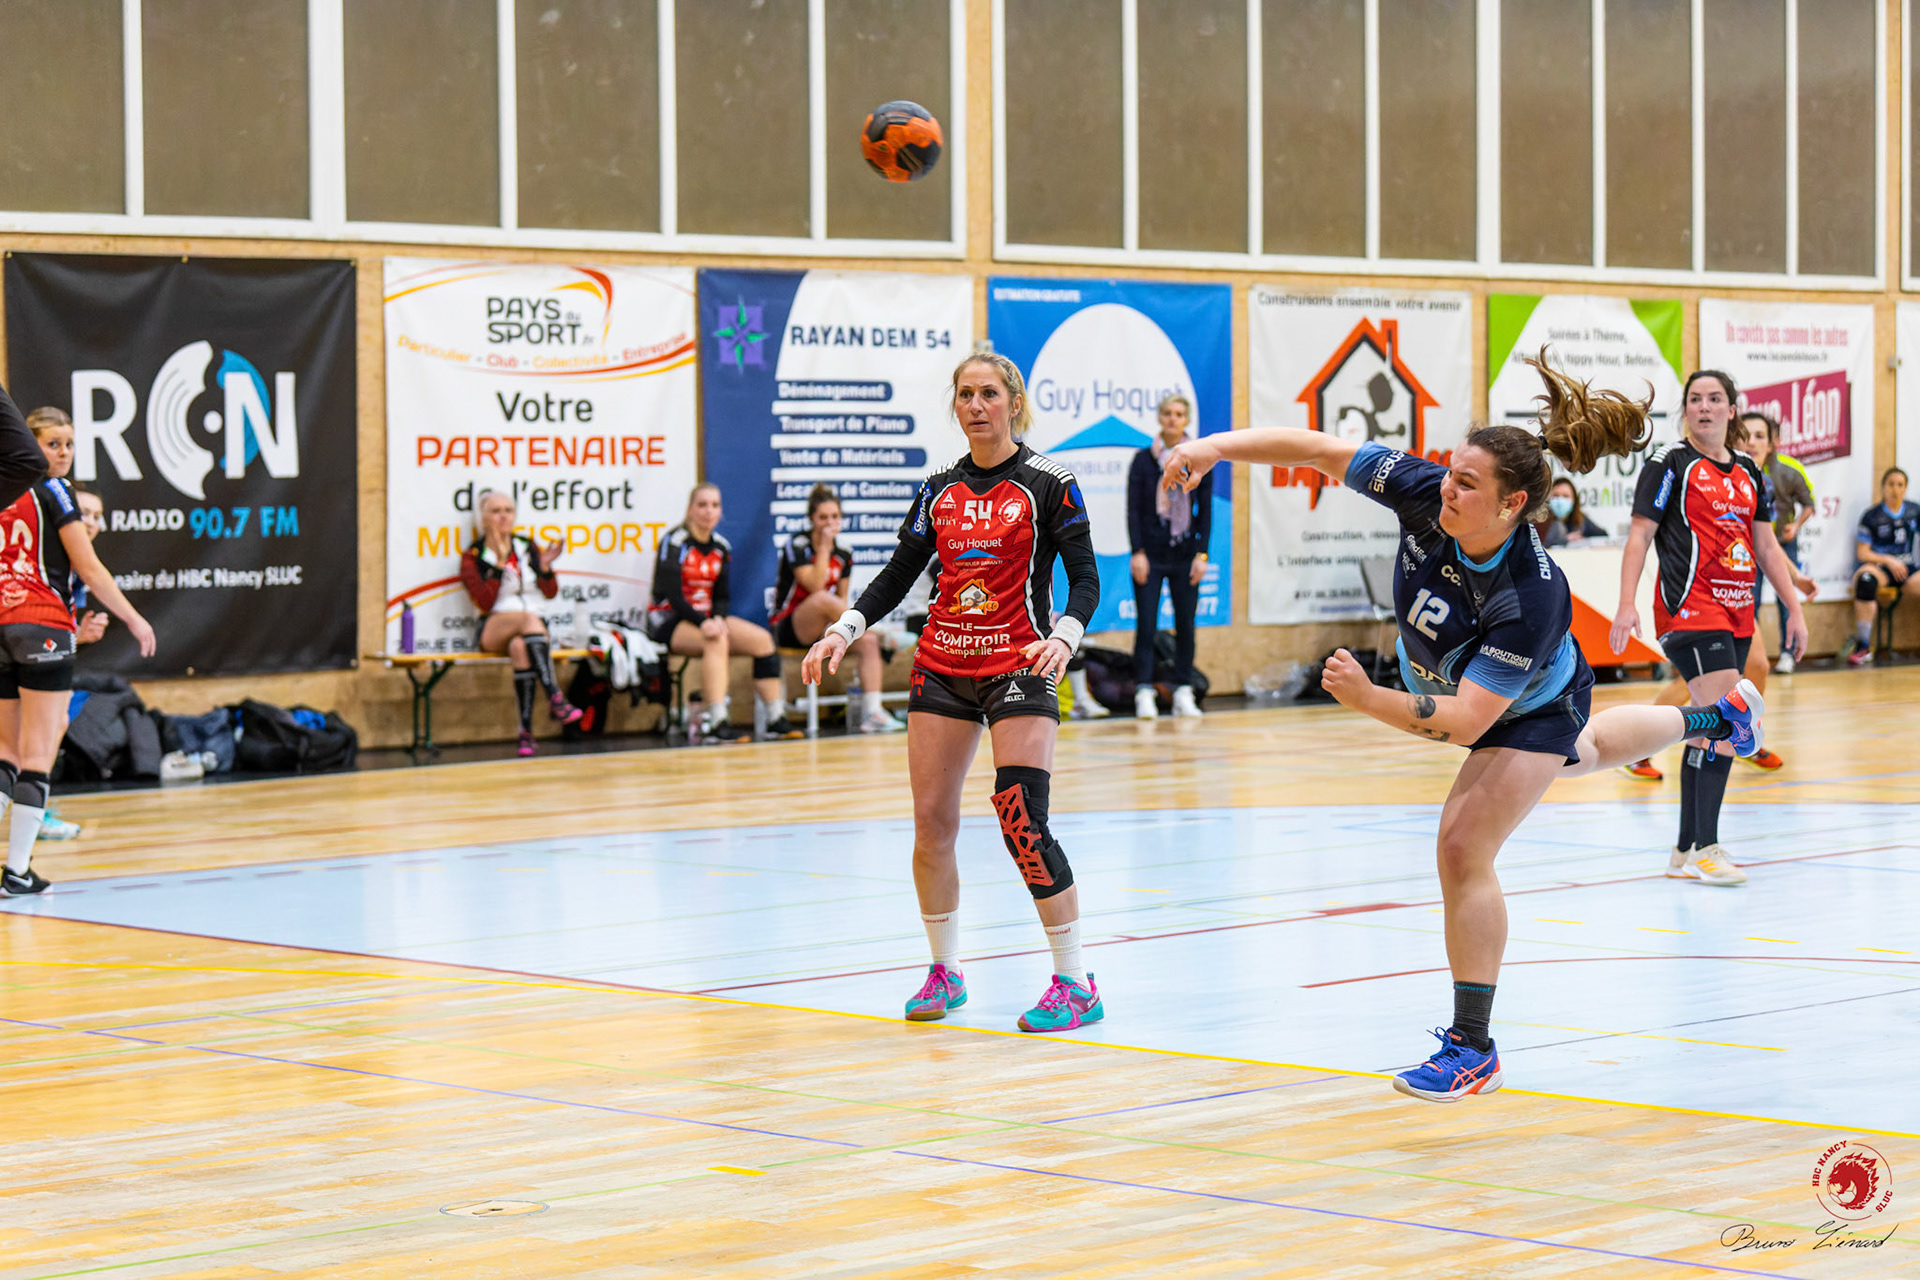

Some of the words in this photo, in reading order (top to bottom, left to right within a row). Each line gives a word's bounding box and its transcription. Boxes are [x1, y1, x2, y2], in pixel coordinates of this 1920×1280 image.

[487, 297, 561, 320] PAYS
[1258, 292, 1333, 307] Construisons
[1336, 296, 1391, 309] ensemble
[1395, 298, 1424, 310] votre
[1427, 300, 1463, 312] avenir
[790, 325, 865, 347] RAYAN
[871, 328, 917, 348] DEM
[925, 330, 952, 349] 54
[1767, 327, 1780, 346] pas
[1783, 326, 1809, 345] comme
[1811, 323, 1822, 346] les
[486, 353, 519, 368] Club
[1564, 353, 1593, 368] Happy
[497, 392, 593, 422] Votre
[1035, 379, 1084, 418] Guy
[1791, 378, 1841, 446] Léon
[780, 415, 846, 433] Transport
[846, 416, 864, 431] de
[865, 415, 909, 431] Piano
[416, 436, 666, 467] PARTENAIRE
[779, 450, 820, 465] Vente
[821, 449, 839, 463] de
[840, 482, 857, 497] de
[858, 483, 913, 498] Camion
[961, 499, 993, 531] 54
[1822, 496, 1840, 518] 57
[110, 508, 185, 533] RADIO
[189, 506, 251, 539] 90.7
[259, 506, 300, 538] FM
[948, 538, 965, 555] Guy
[966, 537, 1003, 554] Hoquet
[116, 569, 153, 590] naire
[155, 568, 176, 589] du
[177, 568, 213, 588] HBC
[213, 567, 263, 591] Nancy
[264, 565, 303, 586] SLUC
[1406, 587, 1451, 642] 12
[960, 622, 973, 632] LE
[934, 629, 1011, 648] COMPTOIR
[1489, 646, 1530, 663] BOUTIQUE
[1003, 694, 1026, 703] SELECT
